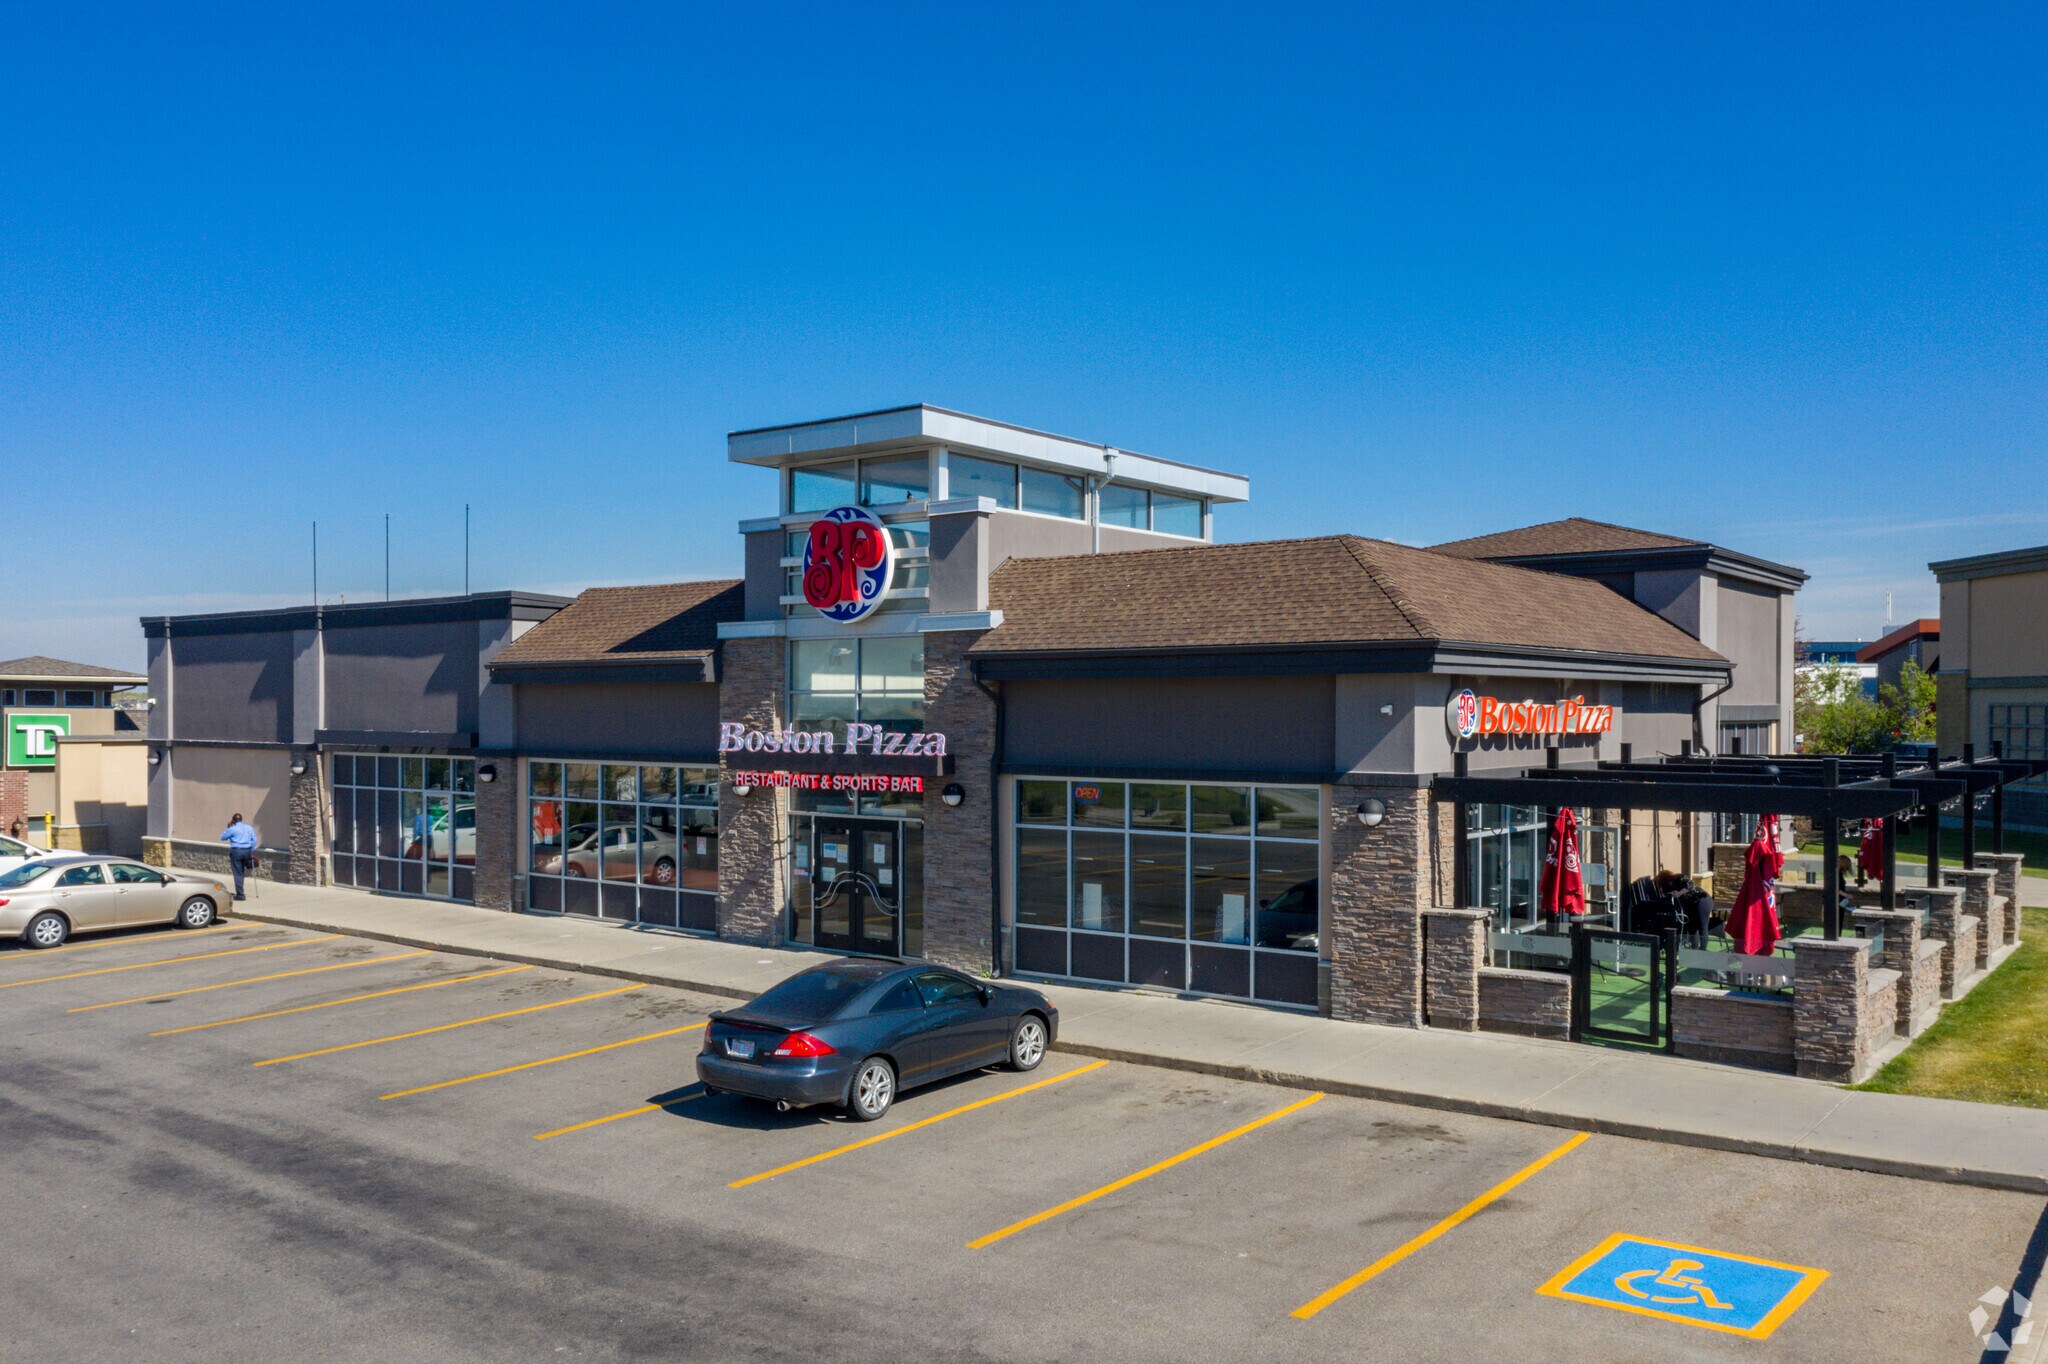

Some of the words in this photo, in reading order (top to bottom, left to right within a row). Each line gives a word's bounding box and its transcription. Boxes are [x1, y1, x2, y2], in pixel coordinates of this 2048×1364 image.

[1479, 696, 1559, 734] Boston
[1561, 694, 1614, 734] Pizza
[16, 724, 65, 757] TD
[718, 721, 834, 754] Boston
[843, 722, 947, 757] Pizza
[735, 771, 818, 789] RESTAURANT
[820, 773, 831, 790] &
[833, 774, 889, 792] SPORTS
[891, 776, 923, 793] BAR
[1075, 786, 1101, 799] OPEN
